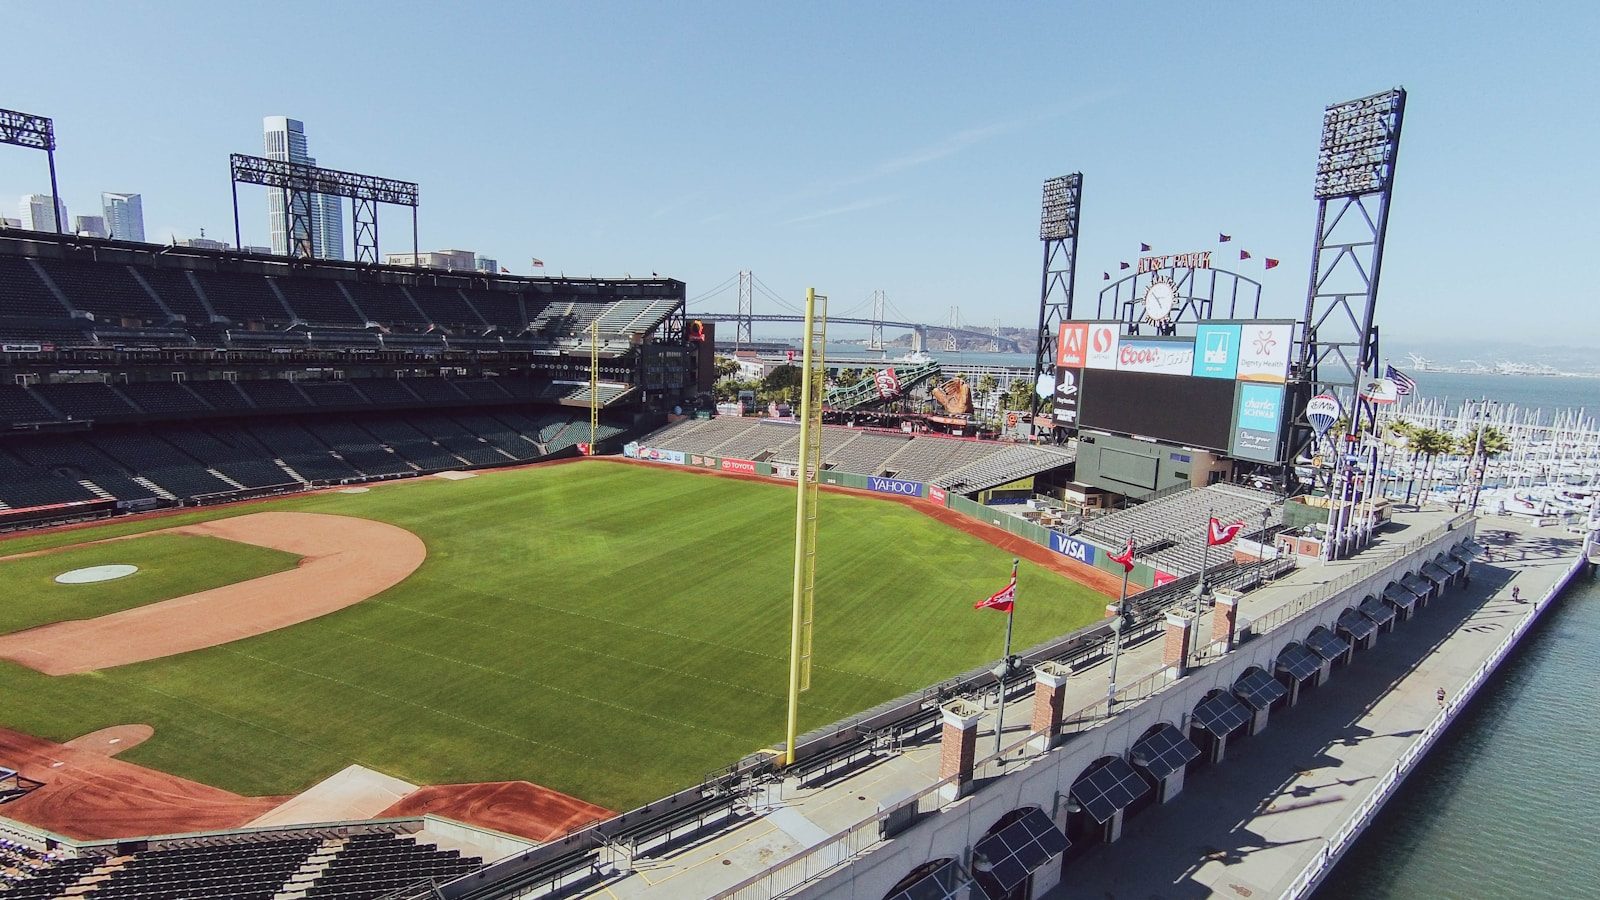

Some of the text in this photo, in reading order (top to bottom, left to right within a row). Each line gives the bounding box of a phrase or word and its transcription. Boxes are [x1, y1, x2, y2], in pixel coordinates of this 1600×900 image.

[1137, 251, 1211, 274] AT&T PARK
[1120, 344, 1160, 365] Coors
[1241, 359, 1284, 368] Dignity Health
[731, 462, 755, 471] TOYOTA
[872, 478, 918, 496] YAHOO!
[1056, 534, 1086, 561] VISA
